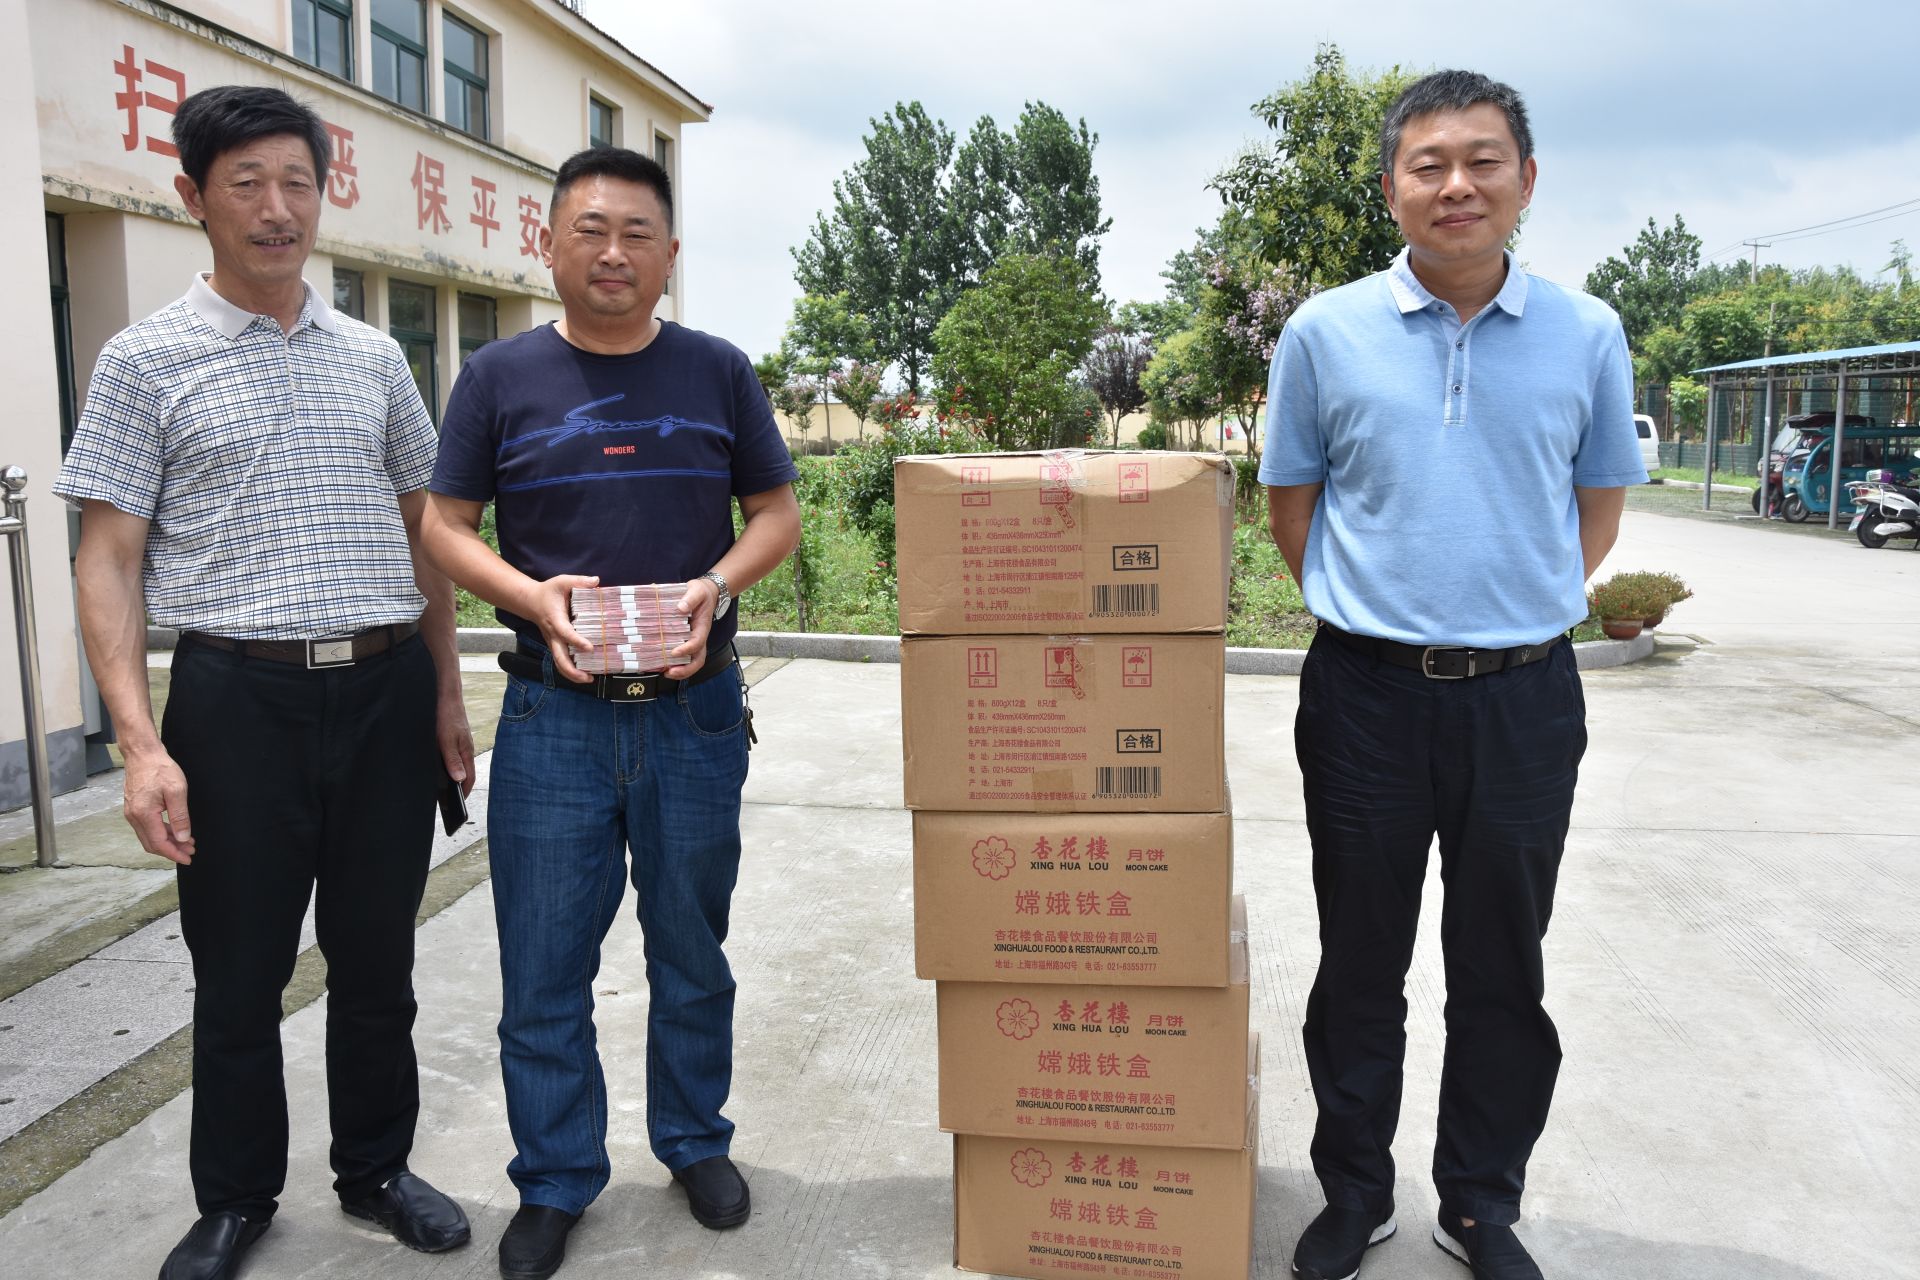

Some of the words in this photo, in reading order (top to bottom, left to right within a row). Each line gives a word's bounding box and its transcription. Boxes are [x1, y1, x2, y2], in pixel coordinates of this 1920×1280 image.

[603, 445, 636, 456] WONDERS
[1120, 550, 1152, 566] 合格
[1123, 734, 1154, 749] 合格
[1127, 849, 1165, 862] 月饼
[1031, 862, 1054, 870] XING
[1060, 862, 1081, 871] HUA
[1089, 862, 1109, 871] LOU
[1015, 890, 1132, 917] 嫦娥铁盒
[995, 930, 1157, 944] 杏花楼食品餐饮股份有限公司
[994, 944, 1043, 953] XINGHUALOU
[1045, 945, 1066, 953] FOOD
[1068, 945, 1074, 954] &
[1076, 945, 1126, 954] RESTAURANT
[1147, 1014, 1184, 1027] 月饼
[1052, 1023, 1076, 1032] XING
[1082, 1024, 1102, 1033] HUA
[1109, 1025, 1129, 1034] LOU
[1145, 1028, 1167, 1036] MOON
[1168, 1029, 1187, 1037] CAKE
[1038, 1050, 1151, 1079] 嫦娥铁盒
[1017, 1087, 1175, 1105] 杏花楼食品餐饮股份有限公司
[1016, 1100, 1063, 1110] XINGHUALOU
[1065, 1102, 1087, 1111] FOOD
[1088, 1103, 1094, 1112] &
[1095, 1103, 1144, 1115] RESTAURANT
[1064, 1175, 1087, 1185] XING
[1092, 1178, 1112, 1187] HUA
[1119, 1181, 1138, 1190] LOU
[1155, 1170, 1191, 1184] 月饼
[1153, 1186, 1174, 1194] MOON
[1175, 1187, 1193, 1196] CAKE
[1050, 1197, 1158, 1230] 嫦娥铁盒
[1030, 1230, 1182, 1257] 杏花楼食品餐饮股份有限公司
[1028, 1245, 1075, 1258] XINGHUALOU
[1075, 1250, 1096, 1260] FOOD
[1097, 1252, 1103, 1261] &
[1104, 1253, 1152, 1266] RESTAURANT
